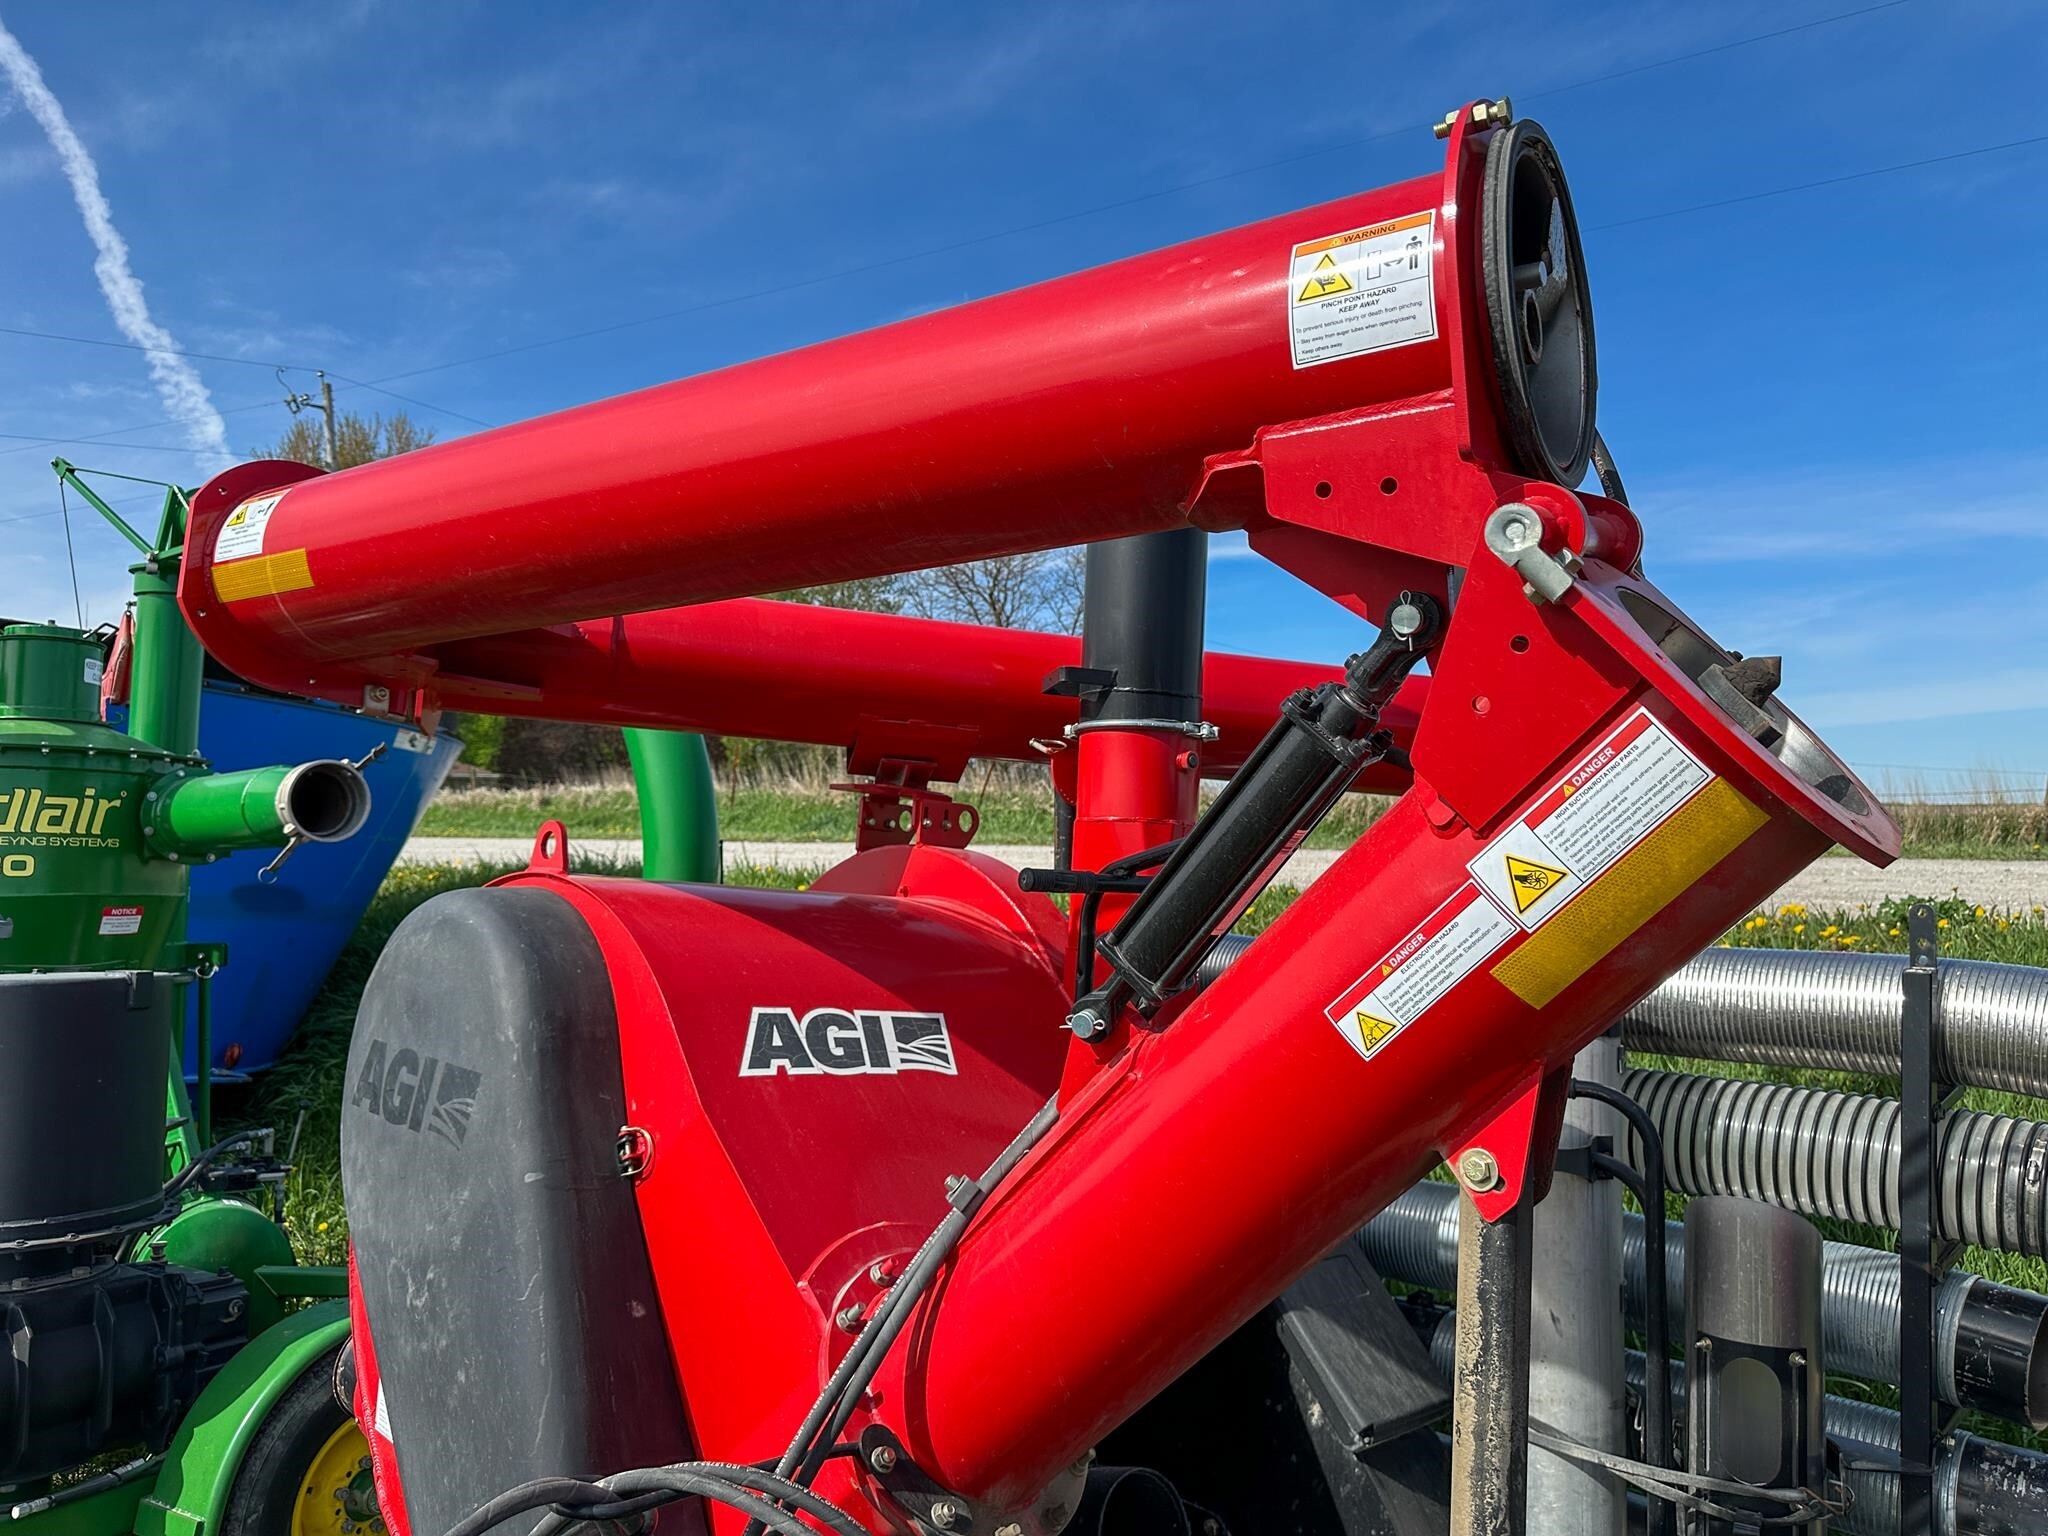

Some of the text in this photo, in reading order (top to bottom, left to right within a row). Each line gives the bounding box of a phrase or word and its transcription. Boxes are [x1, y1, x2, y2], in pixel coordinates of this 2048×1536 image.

[1344, 224, 1395, 242] WARNING
[1303, 323, 1322, 332] prevent
[1324, 319, 1342, 327] serious
[1345, 315, 1359, 323] injury
[1368, 309, 1383, 317] death
[1399, 300, 1421, 310] pinching
[1321, 286, 1396, 308] PINCH POINT HAZARD
[1339, 298, 1379, 313] KEEP AWAY
[1554, 744, 1639, 820] HIGH SUCTION/ROTATING PARTS
[1571, 745, 1615, 787] DANGER
[49, 837, 120, 847] SYSTEMS
[1387, 932, 1426, 967] DANGER
[1400, 921, 1459, 974] ELECTROCUTION HAZARD
[1388, 981, 1404, 996] prevent
[1403, 968, 1419, 983] serious
[1418, 958, 1431, 970] injury
[1389, 926, 1481, 1008] Stay away from overhead electrical wires when
[743, 1009, 896, 1074] AGI
[352, 1039, 438, 1133] AGI
